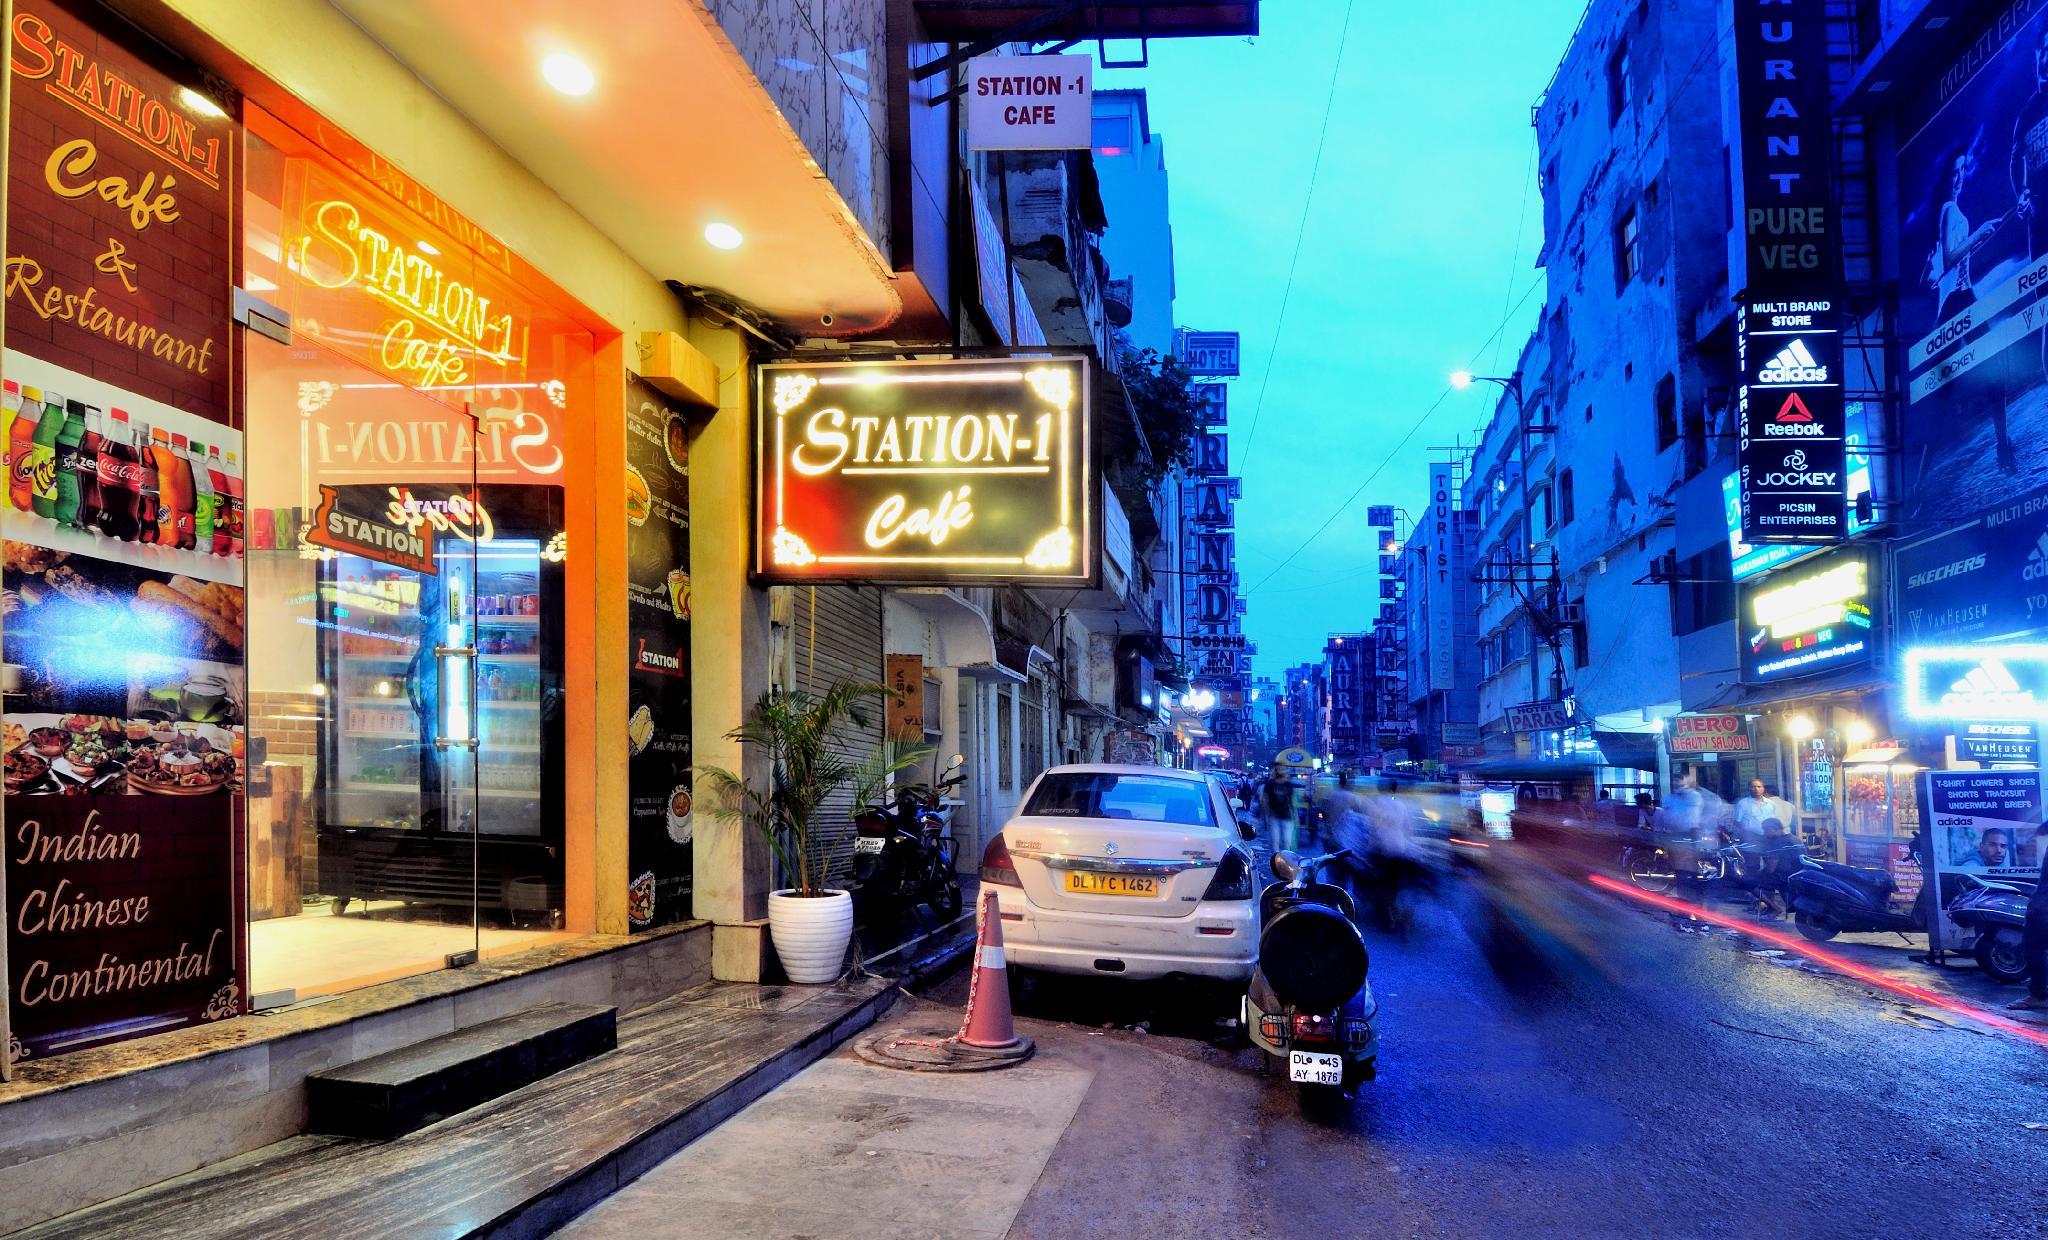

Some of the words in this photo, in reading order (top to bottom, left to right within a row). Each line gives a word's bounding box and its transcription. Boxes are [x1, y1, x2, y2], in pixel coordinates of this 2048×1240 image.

[10, 12, 220, 179] STATION-1
[977, 76, 1061, 96] STATION
[1760, 0, 1800, 194] URANT
[1004, 106, 1056, 125] CAFE
[45, 139, 180, 231] Café
[1749, 207, 1825, 234] PURE
[94, 237, 137, 292] &
[1760, 243, 1819, 269] VEG
[300, 201, 513, 358] STATION-1
[4, 255, 214, 375] Restaurant
[1752, 302, 1788, 313] MULTI
[1789, 301, 1831, 312] BRAND
[1771, 315, 1812, 327] STORE
[1737, 306, 1746, 372] MULTI
[1925, 314, 1972, 355] adidas
[1188, 350, 1236, 369] HOTEL
[1938, 349, 1976, 382] JOCKEY
[1758, 365, 1828, 383] adidas
[1765, 422, 1824, 436] Reebok
[792, 408, 1052, 475] STATION-1
[1757, 472, 1837, 486] JOCKEY
[1742, 464, 1751, 530] STORE
[864, 485, 974, 548] Café
[1779, 503, 1816, 513] PICSIN
[1986, 506, 2021, 529] MULTI
[1435, 474, 1447, 584] TOURIST
[1759, 515, 1837, 526] ENTERPRISES
[328, 512, 424, 557] STATION
[385, 550, 420, 569] CAFE
[1906, 552, 1987, 590] SKECHERS
[1817, 628, 1832, 643] VEG
[642, 648, 679, 669] STATION
[1336, 655, 1353, 728] AURA
[1512, 709, 1566, 731] PARAS
[1517, 705, 1556, 715] HOTEL
[1676, 716, 1739, 734] HERO
[1674, 736, 1710, 750] BEAUTY
[1710, 734, 1749, 750] SALOON
[1805, 763, 1833, 773] BEAUTY
[1805, 774, 1833, 784] SALOON
[1936, 779, 1966, 788] T-SHIRT
[1970, 778, 2004, 788] LOWERS
[2008, 777, 2036, 787] SHOES
[1947, 790, 1979, 799] SHORTS
[1985, 789, 2026, 799] TRACKSUIT
[1948, 801, 1998, 810] UNDERWEAR
[2004, 800, 2033, 809] BRIEFS
[1936, 817, 1974, 827] adidas
[16, 808, 141, 865] Indian
[1987, 867, 2041, 875] SKECHERS
[1073, 875, 1088, 889] DL
[1121, 877, 1153, 892] 1462
[18, 878, 150, 935] Chinese
[20, 928, 223, 1006] Continental
[1294, 1069, 1308, 1080] AY
[1315, 1071, 1338, 1082] 1876
